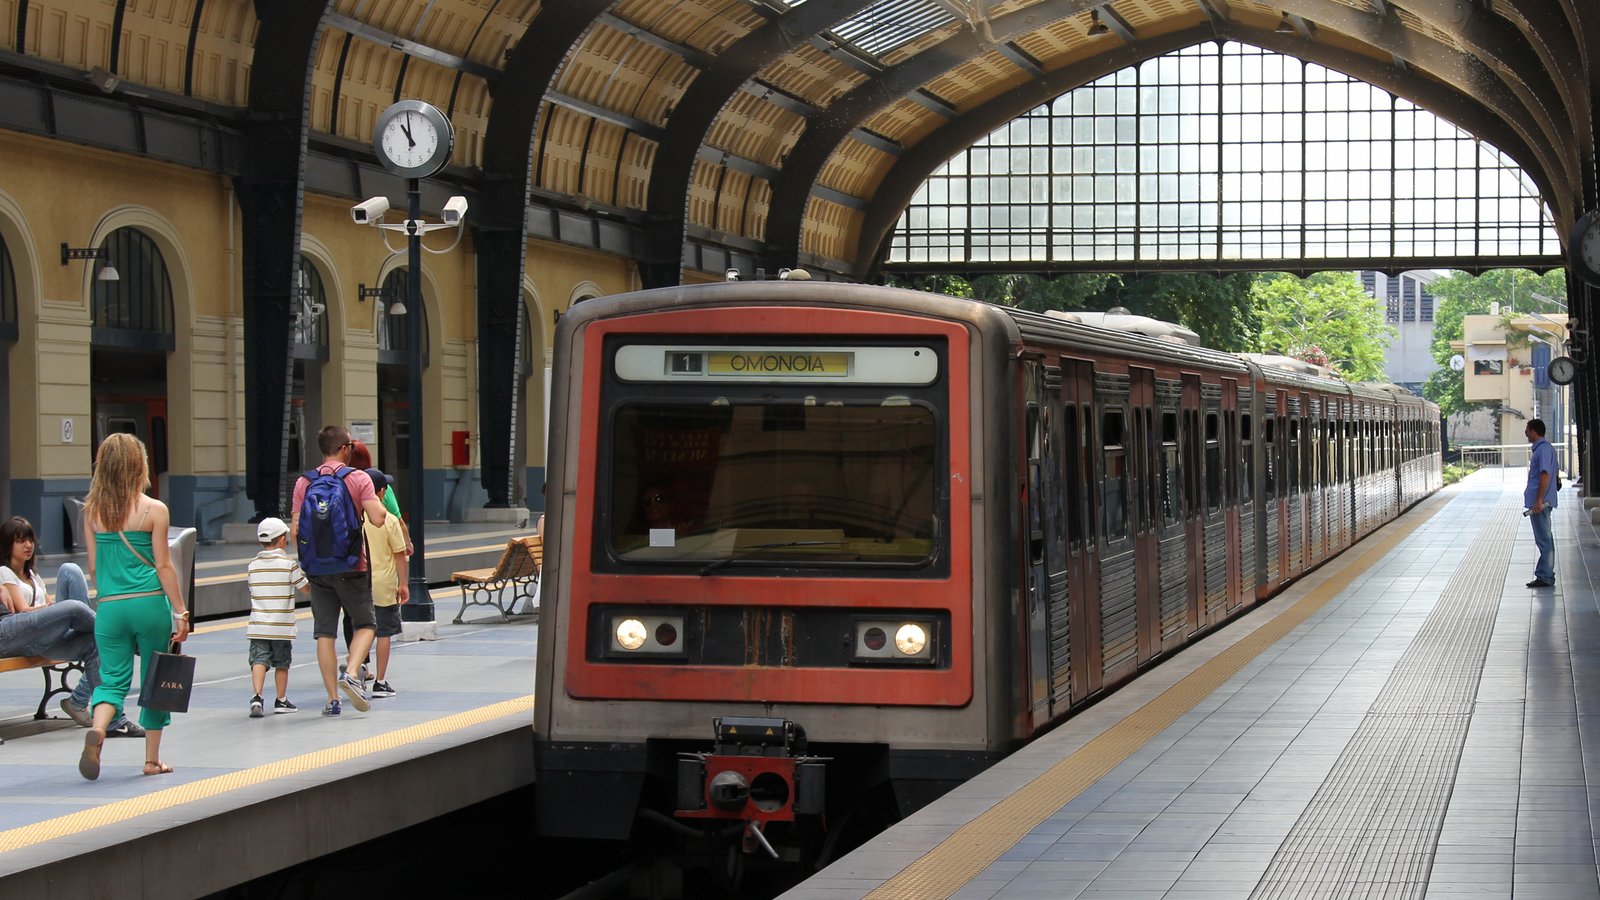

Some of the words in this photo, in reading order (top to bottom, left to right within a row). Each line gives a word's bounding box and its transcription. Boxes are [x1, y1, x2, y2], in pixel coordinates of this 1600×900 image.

[1587, 232, 1594, 240] 10
[682, 354, 690, 371] 1
[730, 355, 825, 372] OMONOIA
[160, 681, 183, 689] ZARA
